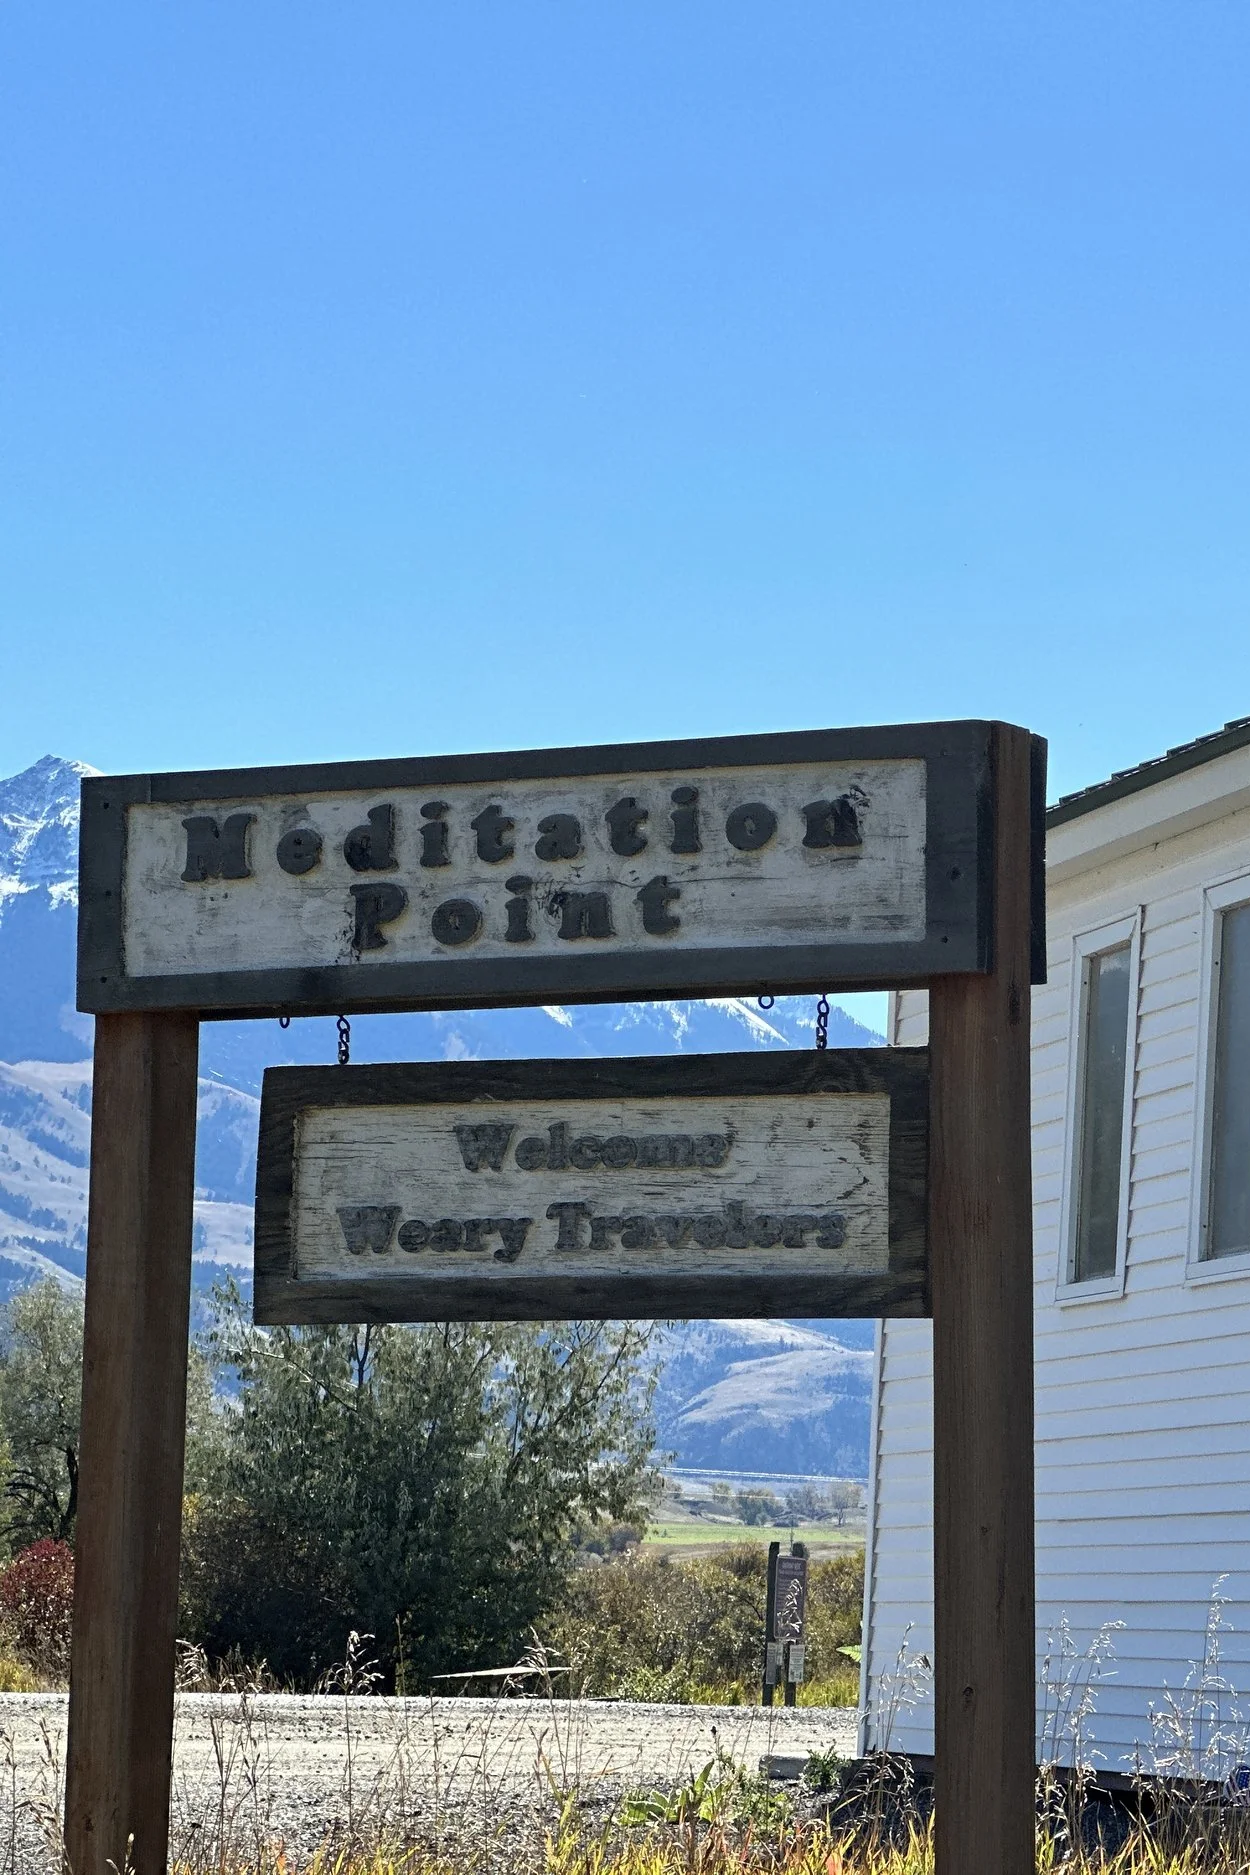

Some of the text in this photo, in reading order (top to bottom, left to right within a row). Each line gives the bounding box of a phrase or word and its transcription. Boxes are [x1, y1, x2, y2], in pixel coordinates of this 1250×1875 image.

[180, 786, 865, 882] Meditation
[348, 875, 681, 952] Point
[455, 1121, 730, 1173] Welcome
[338, 1200, 848, 1263] Weary Travelers
